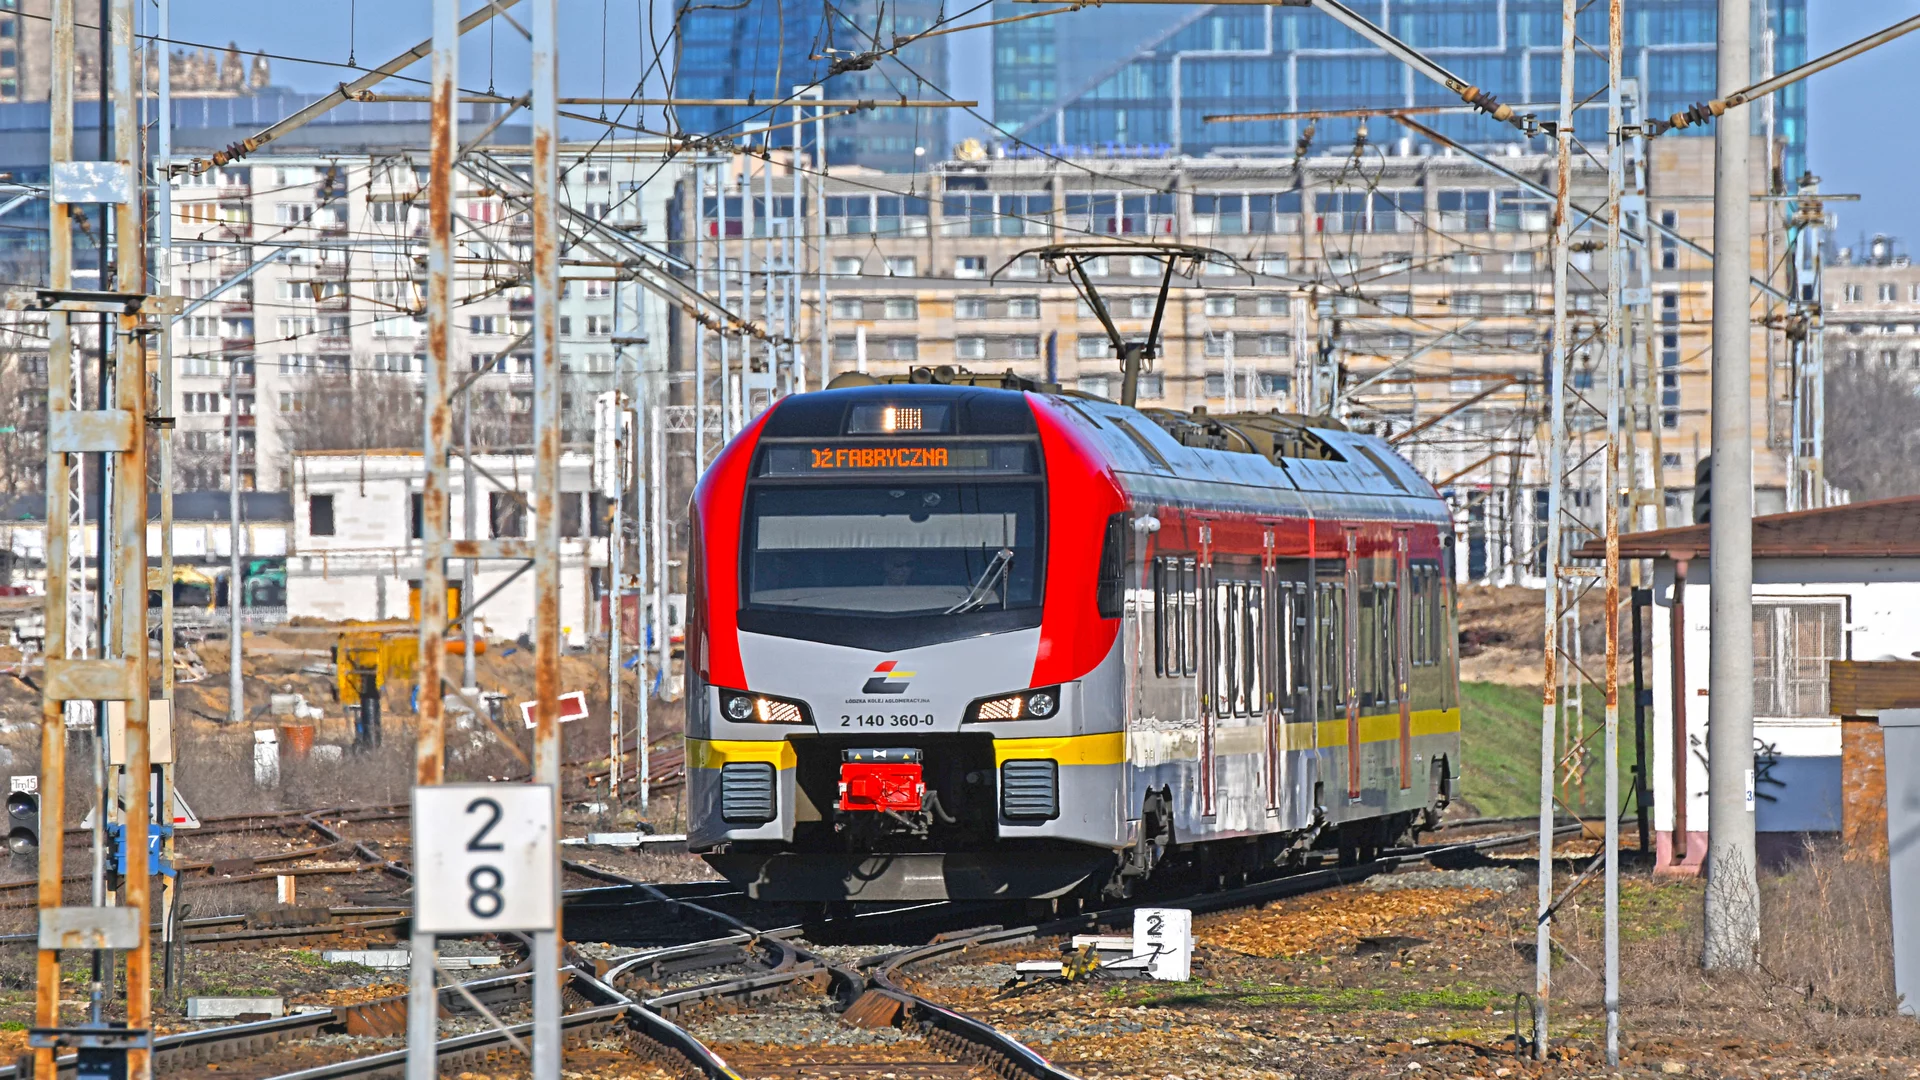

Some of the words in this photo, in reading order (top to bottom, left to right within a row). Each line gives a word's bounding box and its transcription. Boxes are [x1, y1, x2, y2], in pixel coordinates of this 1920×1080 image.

[836, 448, 948, 467] FABRYCZNA
[841, 715, 850, 727] 2
[856, 714, 884, 727] 140
[890, 714, 934, 727] 360-0
[465, 796, 505, 852] 2
[466, 864, 505, 919] 8
